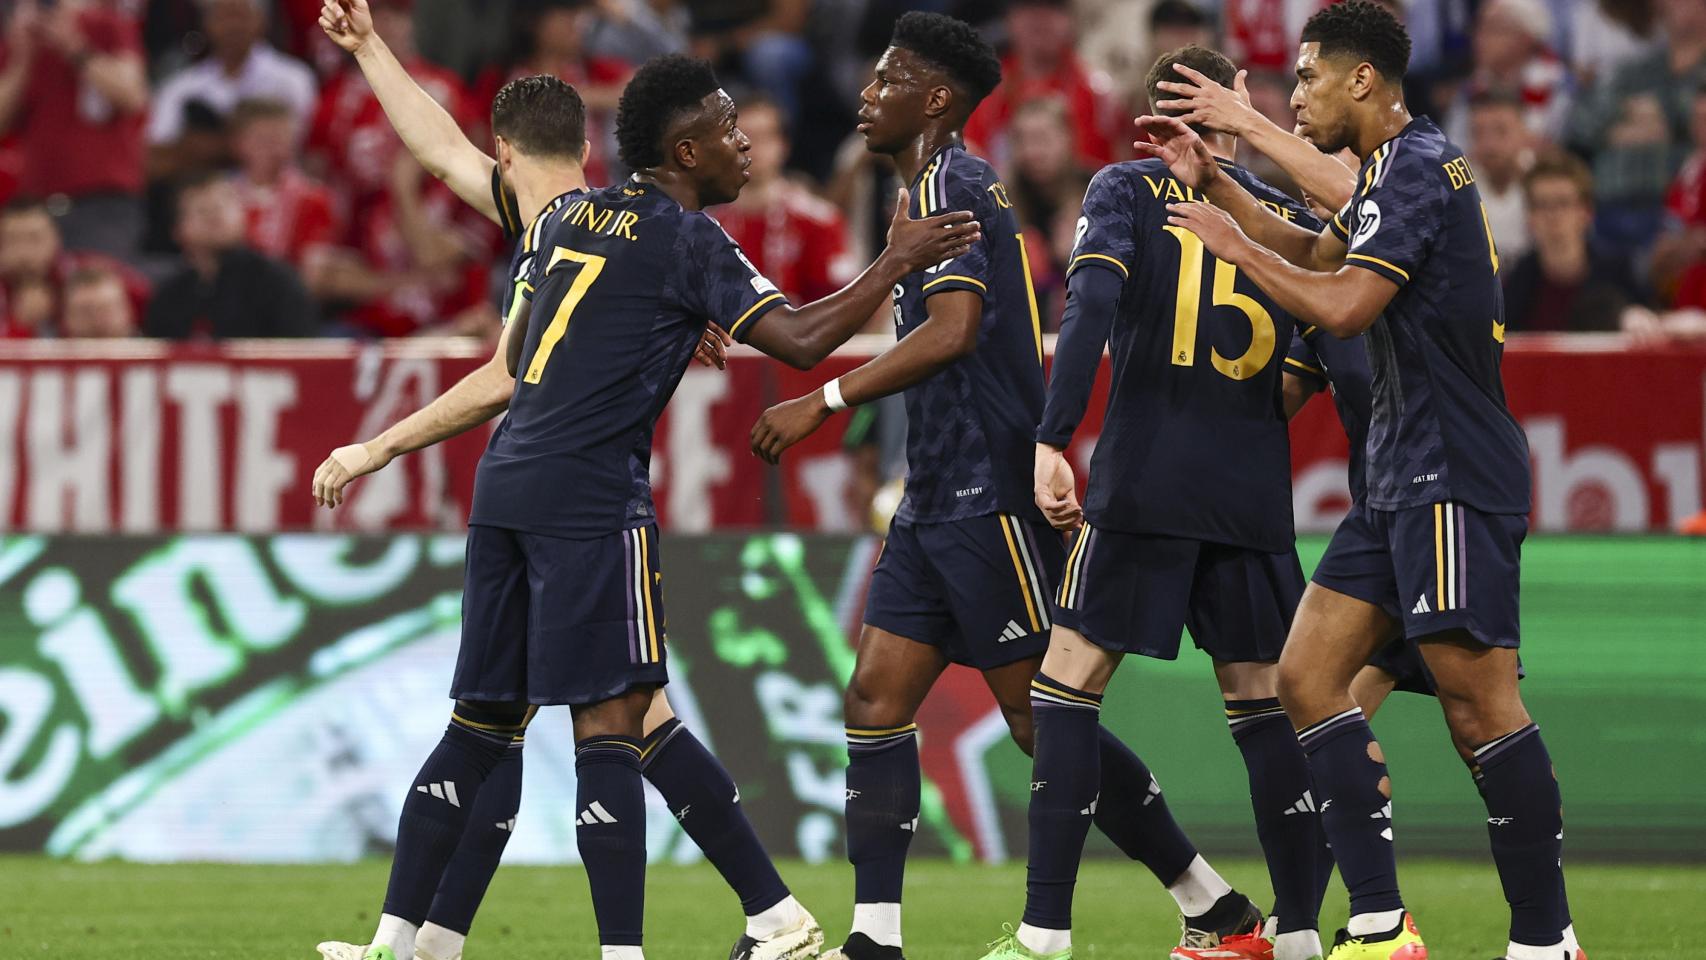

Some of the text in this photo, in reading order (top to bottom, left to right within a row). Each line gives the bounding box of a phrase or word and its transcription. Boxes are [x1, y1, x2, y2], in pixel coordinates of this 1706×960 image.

[561, 200, 639, 241] VINI JR.
[1142, 175, 1297, 221] VALDE
[523, 246, 607, 385] 7
[1162, 225, 1276, 380] 15
